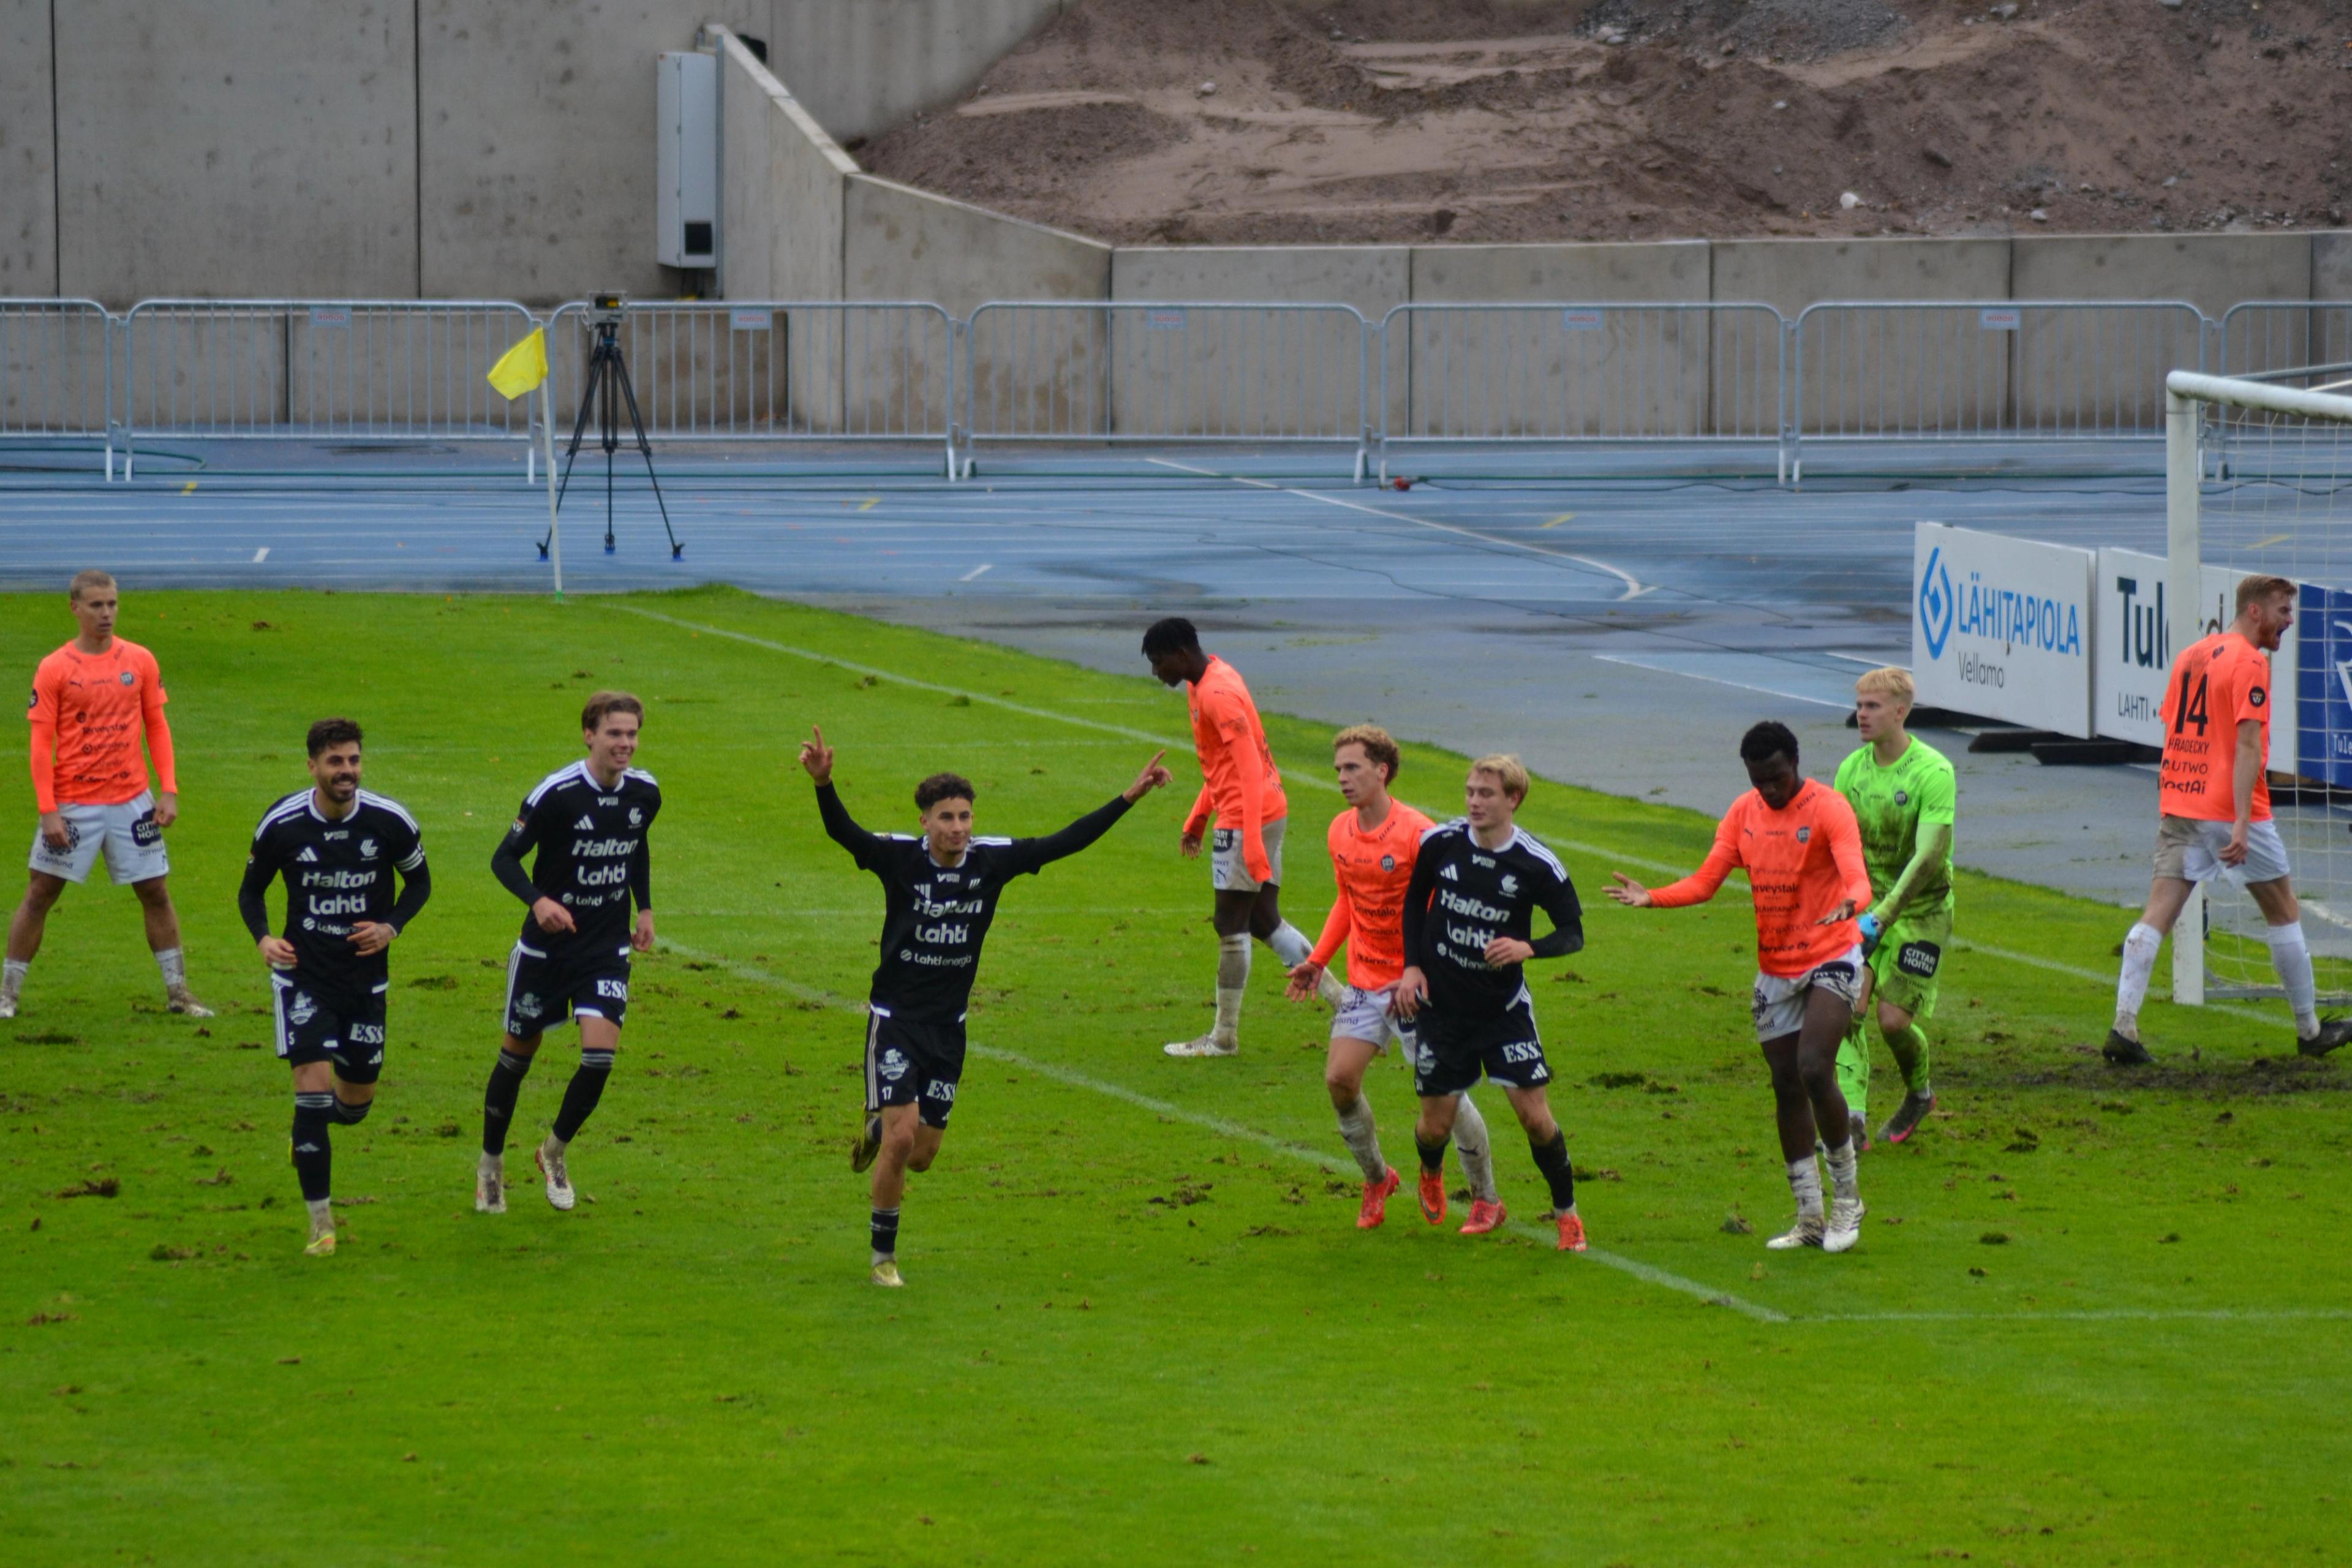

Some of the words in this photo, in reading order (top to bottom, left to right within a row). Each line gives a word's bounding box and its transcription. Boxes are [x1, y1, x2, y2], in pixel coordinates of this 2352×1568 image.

[1958, 571, 2080, 657] LÄHITAPIOLA
[2117, 576, 2169, 671] Tul
[1958, 651, 2004, 689] Vellamo
[2119, 692, 2149, 722] LAHTI
[2174, 671, 2209, 737] 14
[2168, 737, 2210, 755] HRADECKY
[571, 839, 638, 857] Halton
[36, 853, 74, 870] Granlund
[301, 870, 377, 889] Halton
[578, 862, 626, 886] Lahti
[309, 894, 366, 915] Lahti
[1440, 889, 1510, 923] Halton
[915, 922, 970, 944] Lahti
[1903, 956, 1933, 975] HOITAA
[1905, 948, 1936, 966] CITTARI
[882, 1086, 892, 1100] 17
